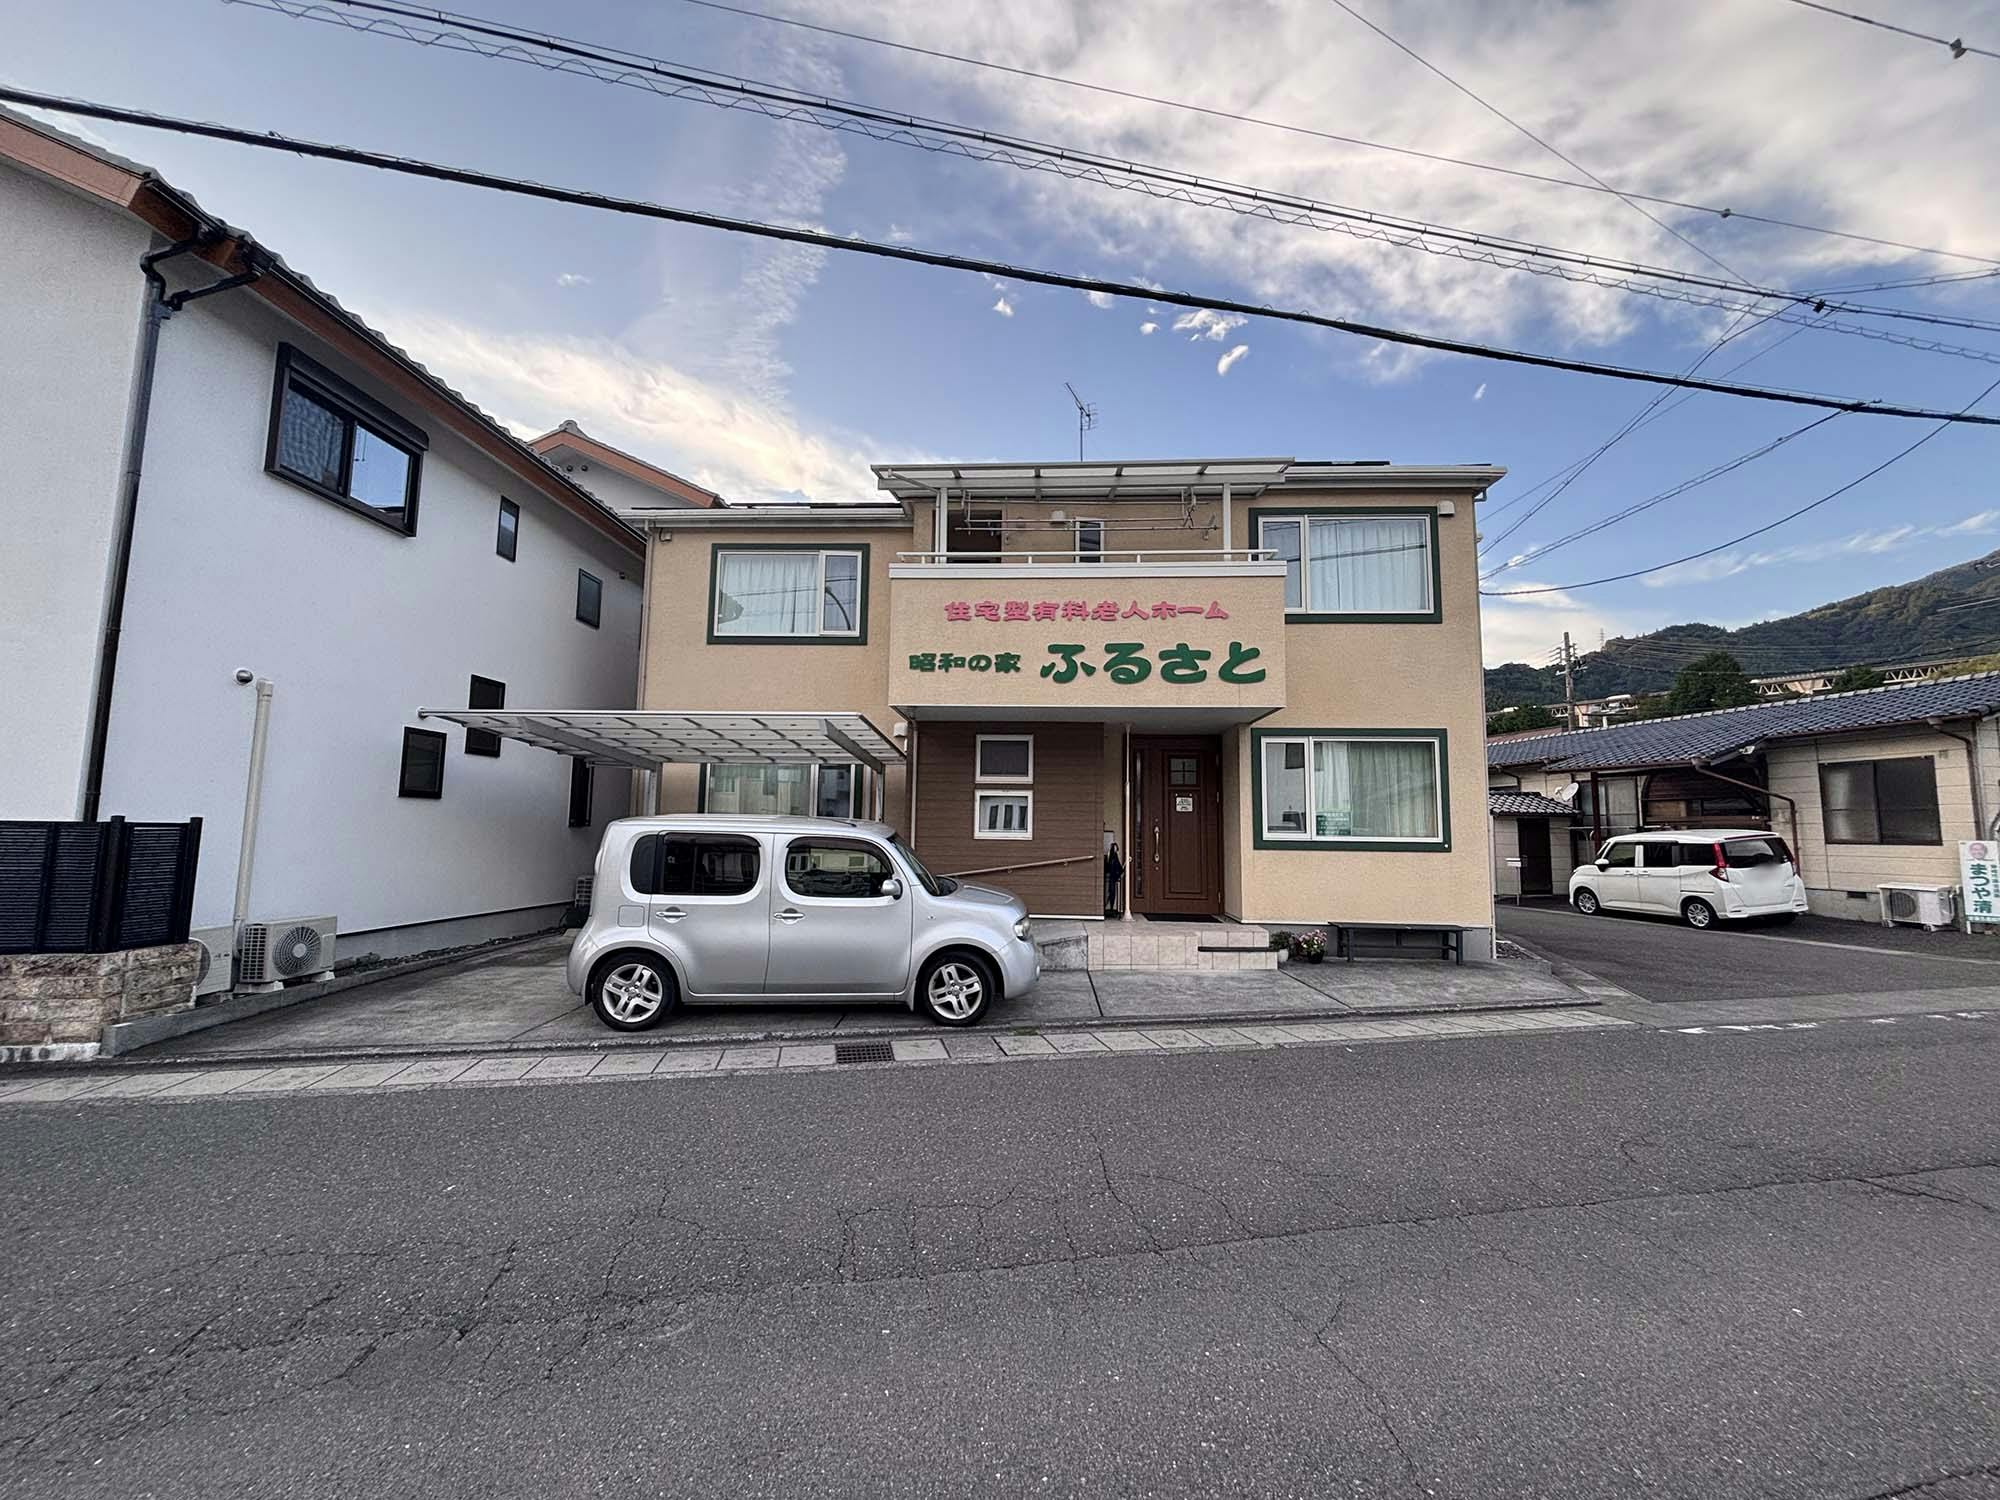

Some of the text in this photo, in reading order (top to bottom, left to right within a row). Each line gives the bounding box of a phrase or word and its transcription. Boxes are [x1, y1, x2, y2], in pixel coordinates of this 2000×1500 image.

[945, 600, 1229, 621] 住宅型有料老人ホーム
[908, 641, 1267, 685] 昭和の家 ふるさと
